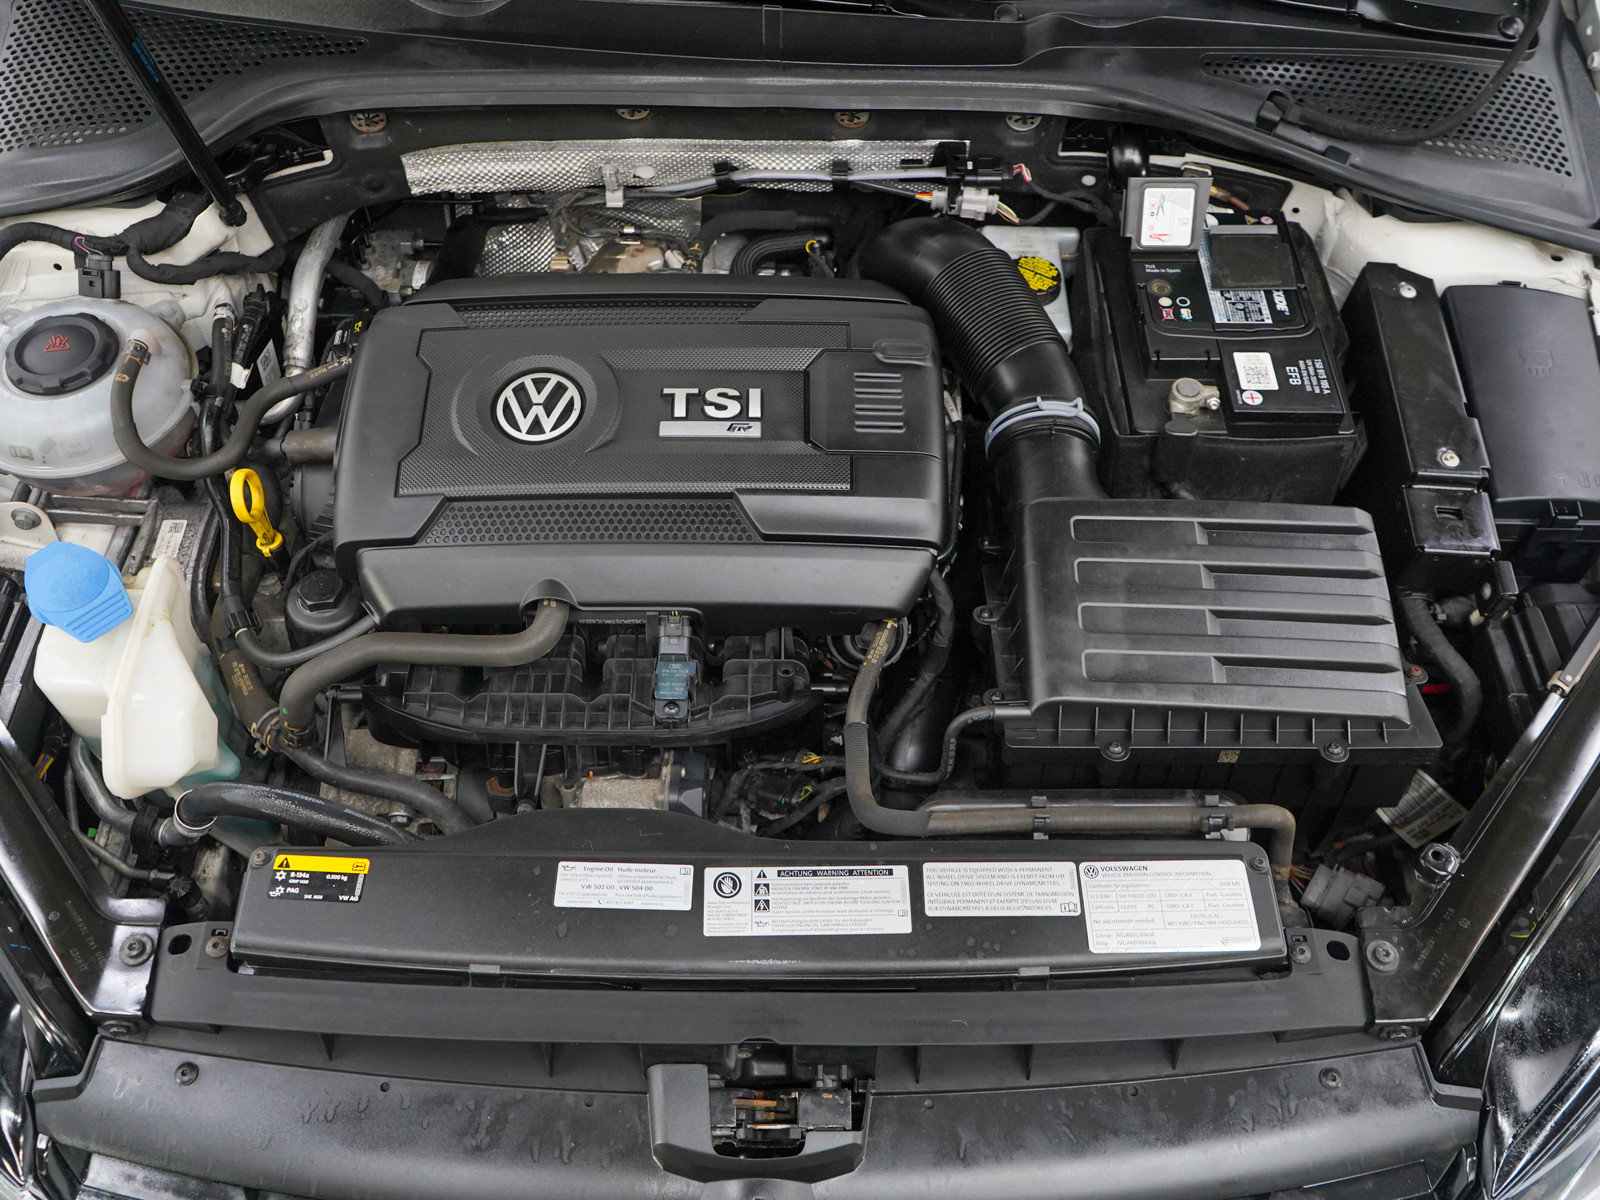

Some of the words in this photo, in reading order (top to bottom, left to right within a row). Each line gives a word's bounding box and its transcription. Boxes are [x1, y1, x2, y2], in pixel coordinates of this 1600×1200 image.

[1285, 366, 1302, 386] EFB
[662, 387, 761, 419] TSI
[290, 871, 310, 879] R-134a
[816, 869, 849, 877] WARNING
